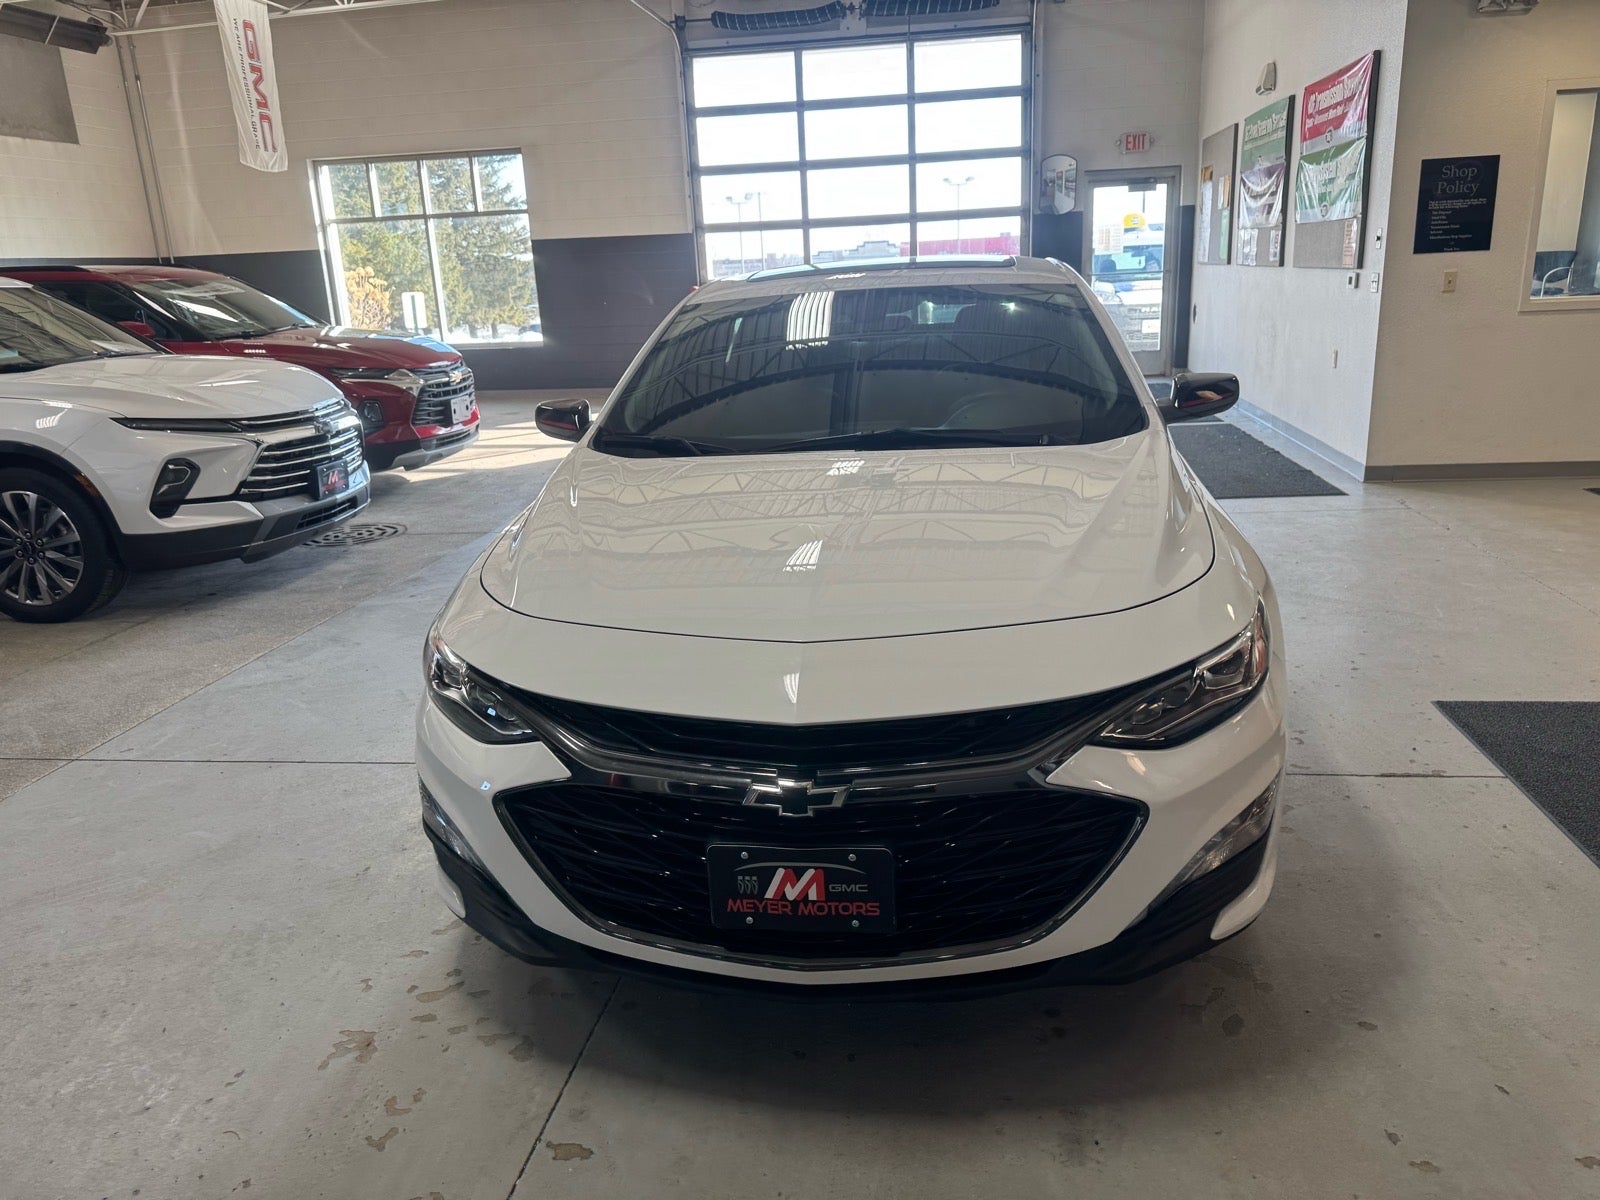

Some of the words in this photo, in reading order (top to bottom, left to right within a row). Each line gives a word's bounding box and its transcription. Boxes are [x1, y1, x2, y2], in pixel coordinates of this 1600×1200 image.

[233, 17, 239, 31] WE
[240, 52, 255, 120] PROFESSIONAL
[242, 19, 278, 153] GMC
[1125, 133, 1147, 151] EXIT
[1442, 165, 1477, 180] Shop
[1438, 181, 1479, 196] Policy
[829, 883, 868, 893] GMC
[727, 899, 792, 915] MEYER
[797, 901, 881, 917] MOTORS
